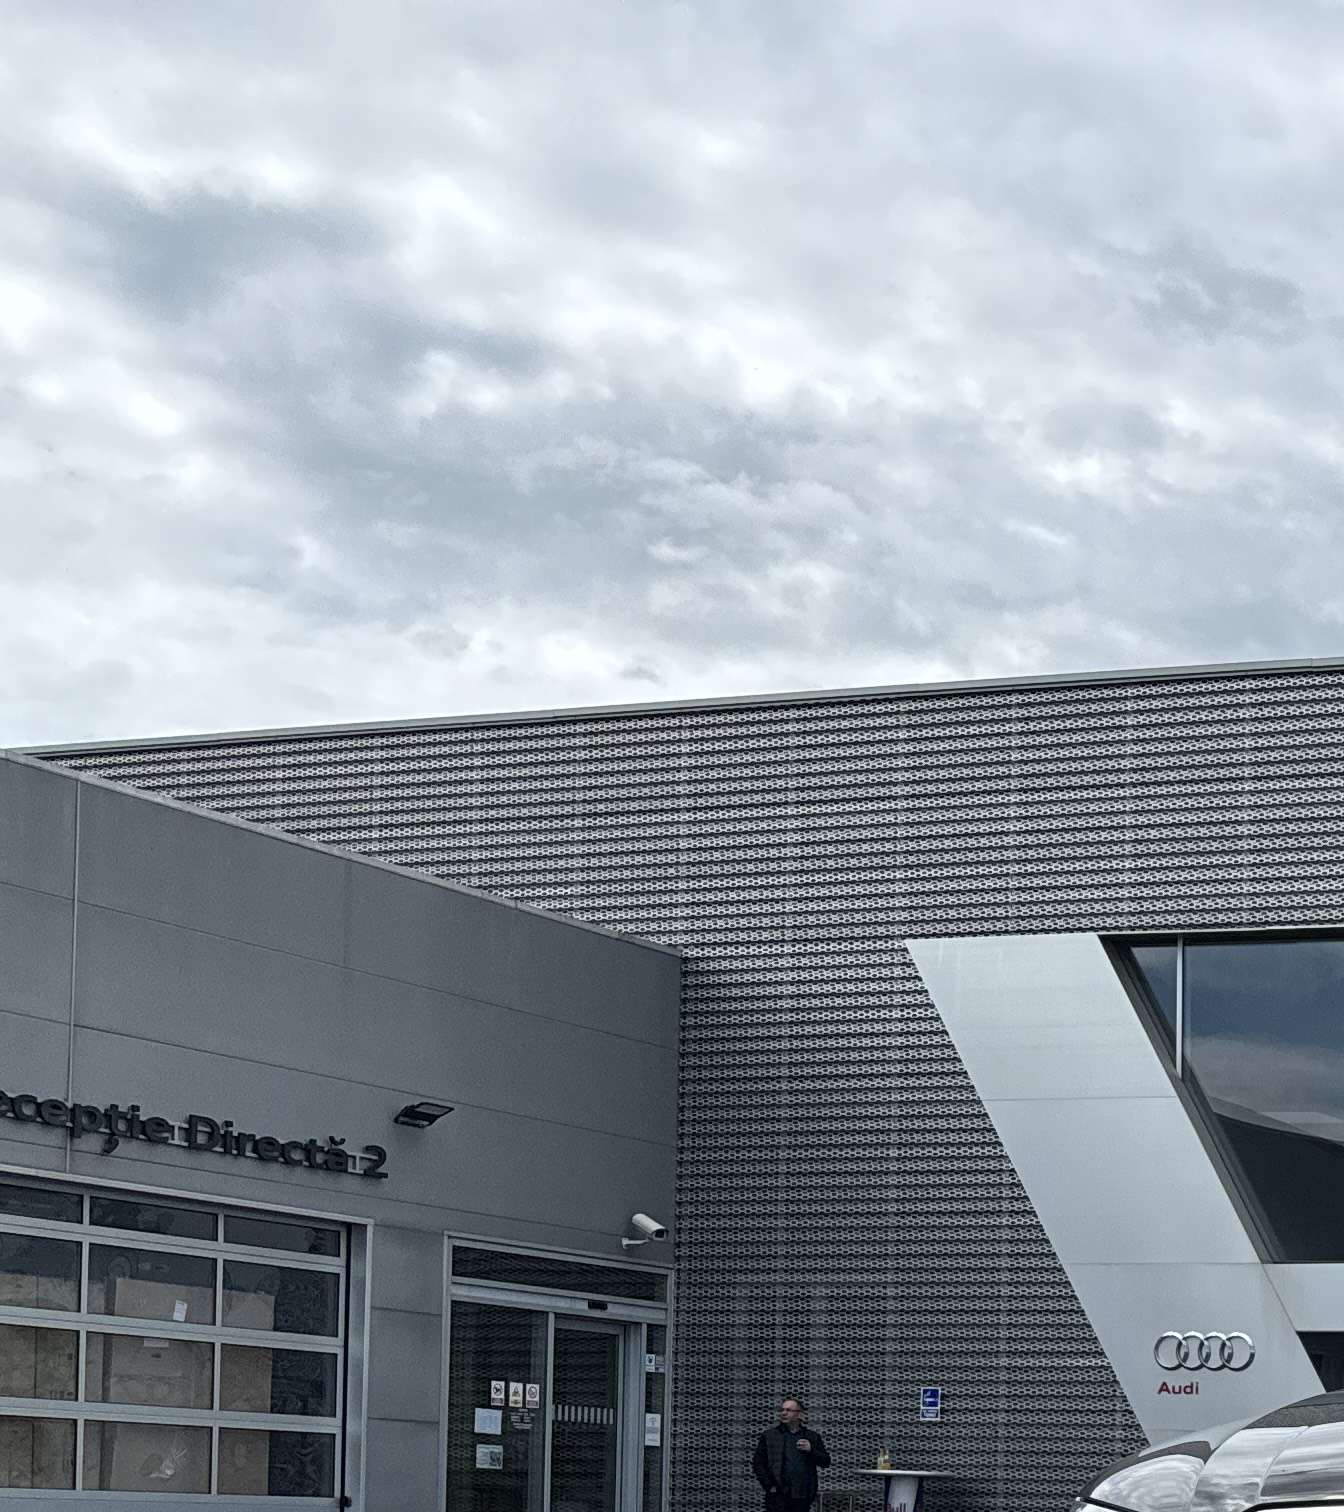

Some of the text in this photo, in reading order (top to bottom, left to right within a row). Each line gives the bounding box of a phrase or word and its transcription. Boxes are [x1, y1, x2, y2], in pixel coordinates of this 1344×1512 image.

[188, 1114, 349, 1172] Directă
[362, 1144, 389, 1179] 2
[1157, 1381, 1199, 1395] Audi
